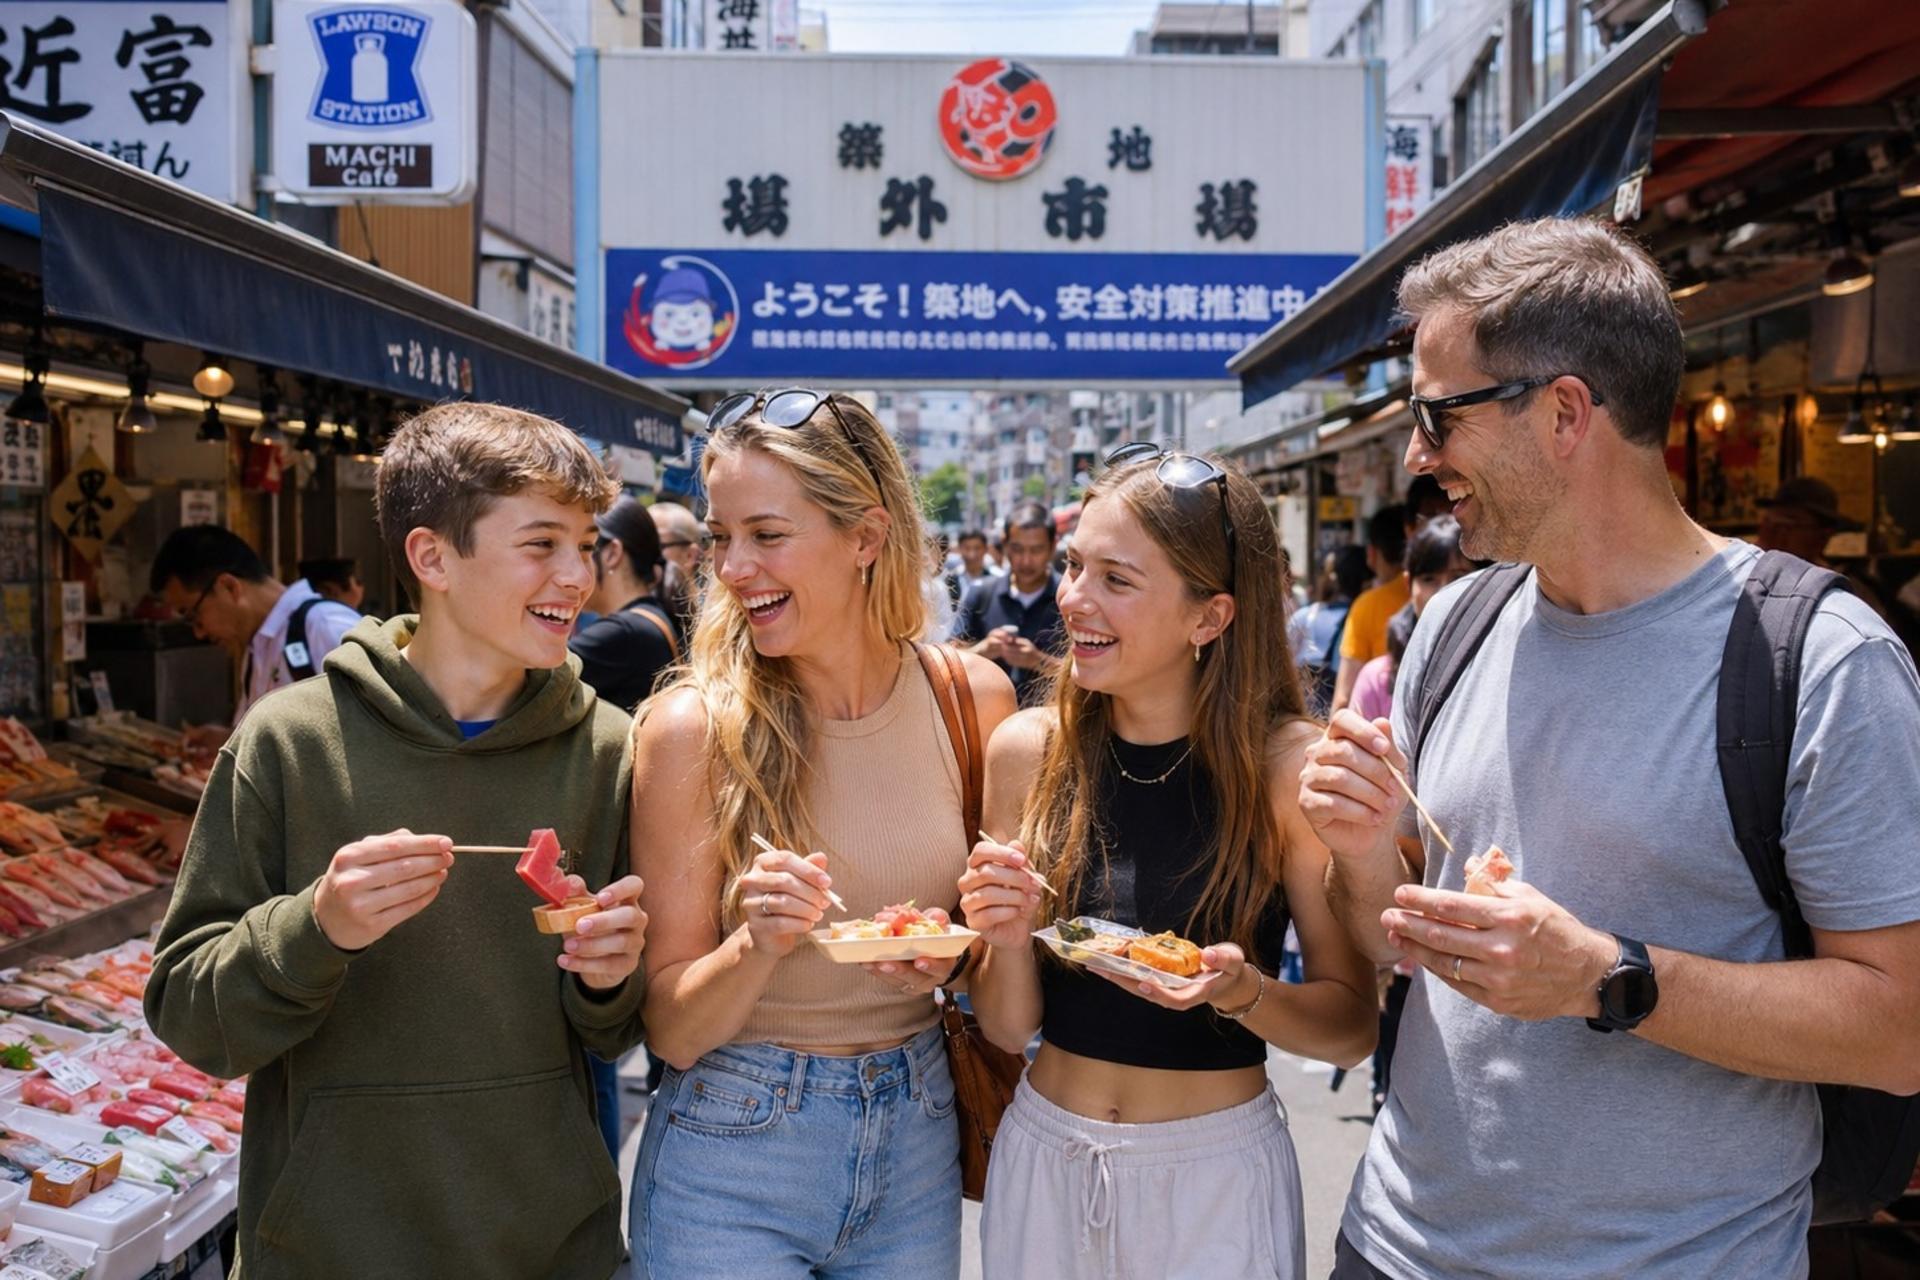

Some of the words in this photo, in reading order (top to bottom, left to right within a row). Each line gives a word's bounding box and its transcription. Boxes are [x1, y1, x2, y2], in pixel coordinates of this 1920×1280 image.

[318, 13, 421, 38] LAWSON
[319, 98, 420, 123] STATION
[325, 146, 416, 166] MACHI
[341, 166, 399, 186] Café
